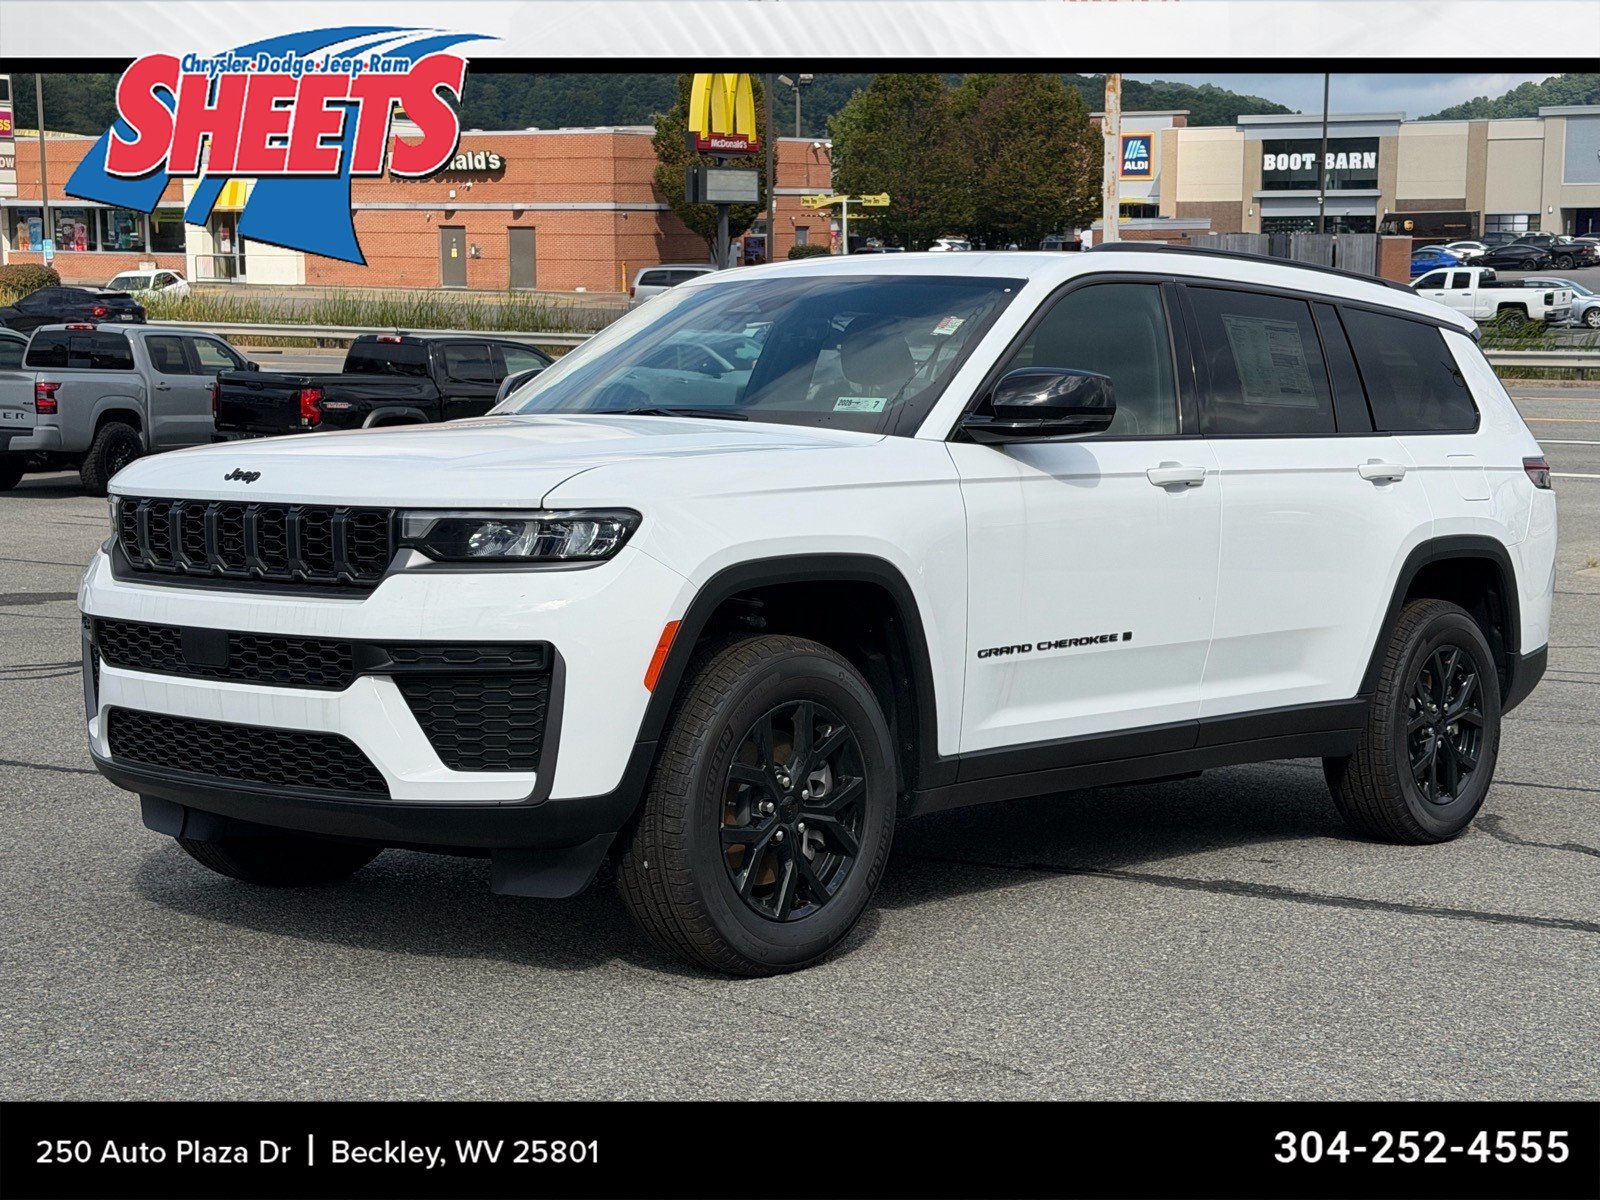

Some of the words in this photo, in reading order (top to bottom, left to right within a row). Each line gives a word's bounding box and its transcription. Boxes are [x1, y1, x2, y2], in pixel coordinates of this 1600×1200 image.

[711, 139, 748, 149] McDonald's
[1124, 160, 1149, 170] ALDI
[1263, 153, 1316, 170] BOOT
[1325, 152, 1376, 169] BARN
[224, 468, 261, 484] Jeep
[977, 643, 1033, 659] GRAND
[1036, 633, 1119, 651] CHEROKEE
